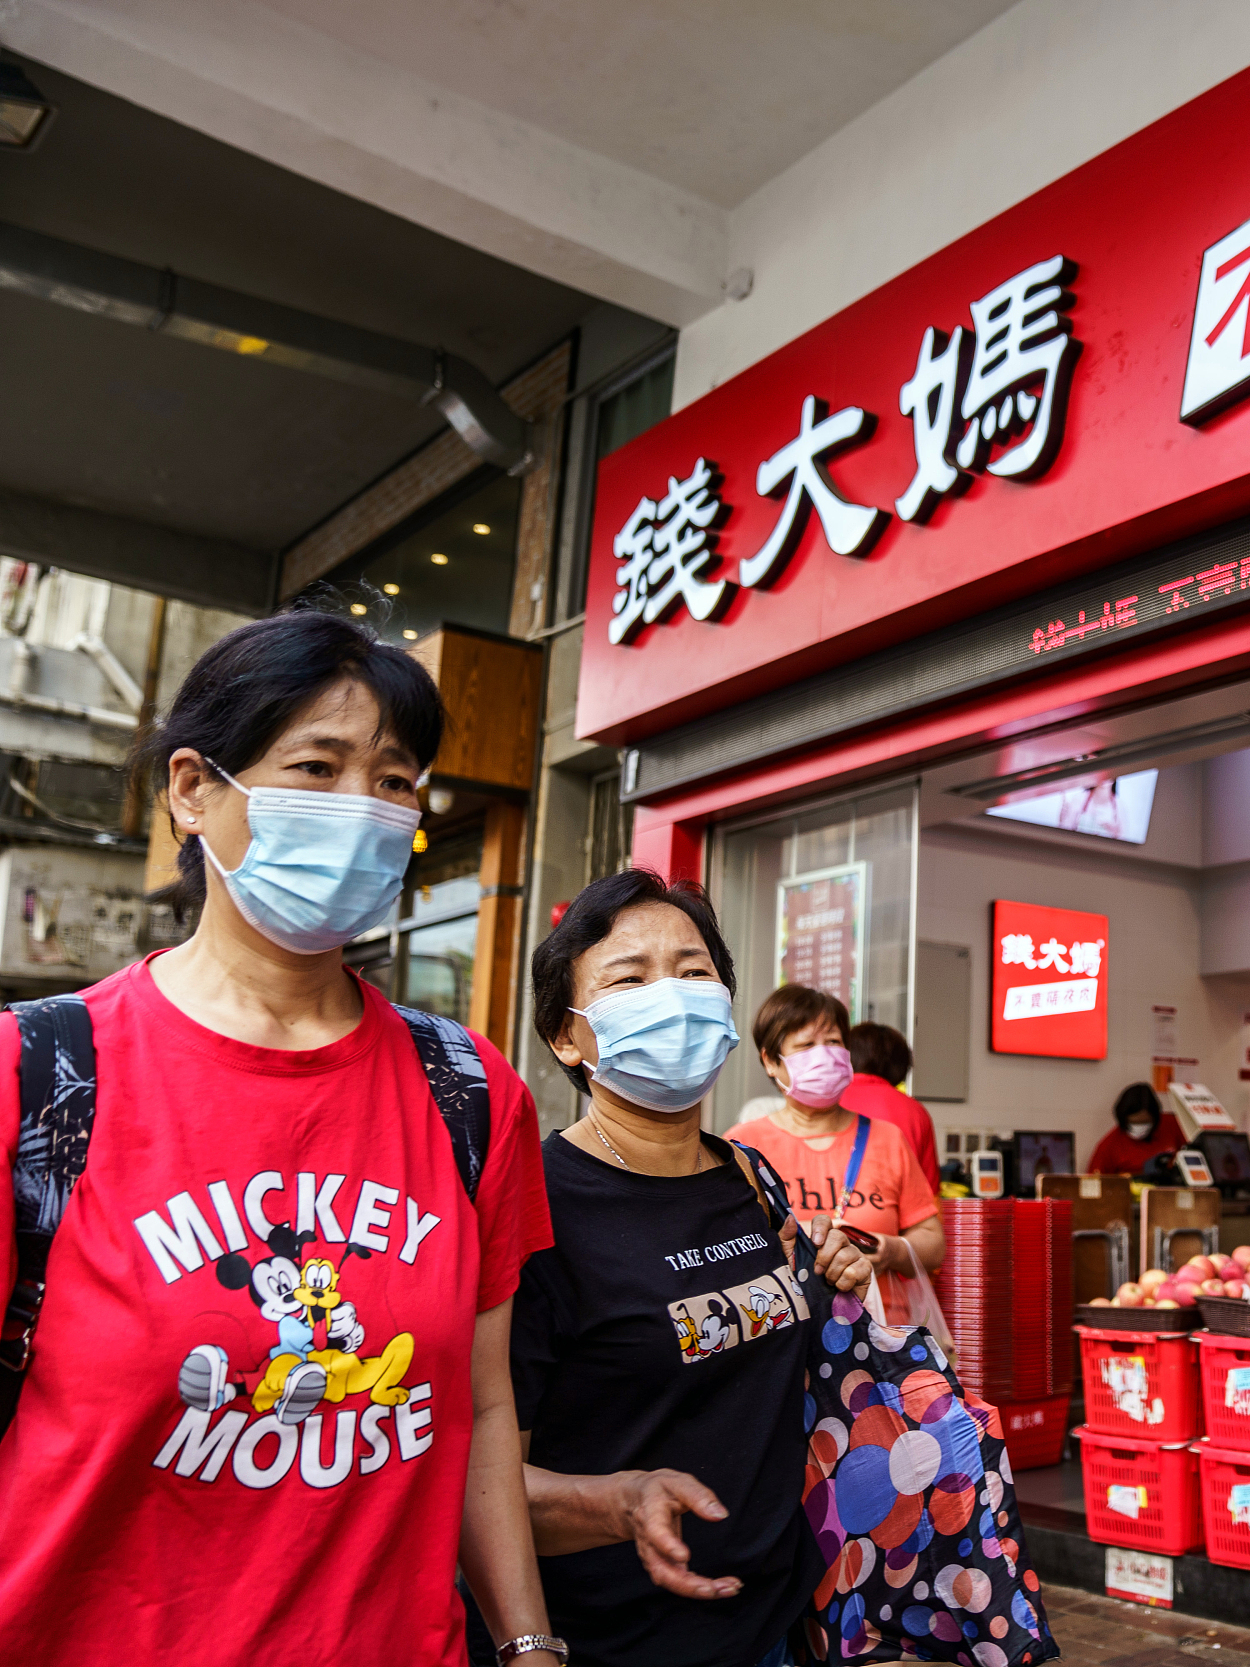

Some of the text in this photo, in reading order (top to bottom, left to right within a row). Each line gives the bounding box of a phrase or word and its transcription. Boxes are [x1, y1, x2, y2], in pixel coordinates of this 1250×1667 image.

[608, 254, 1069, 646] 錢大媽
[133, 1170, 442, 1285] MICKEY
[664, 1248, 704, 1271] TAKE
[152, 1382, 435, 1489] MOUSE
